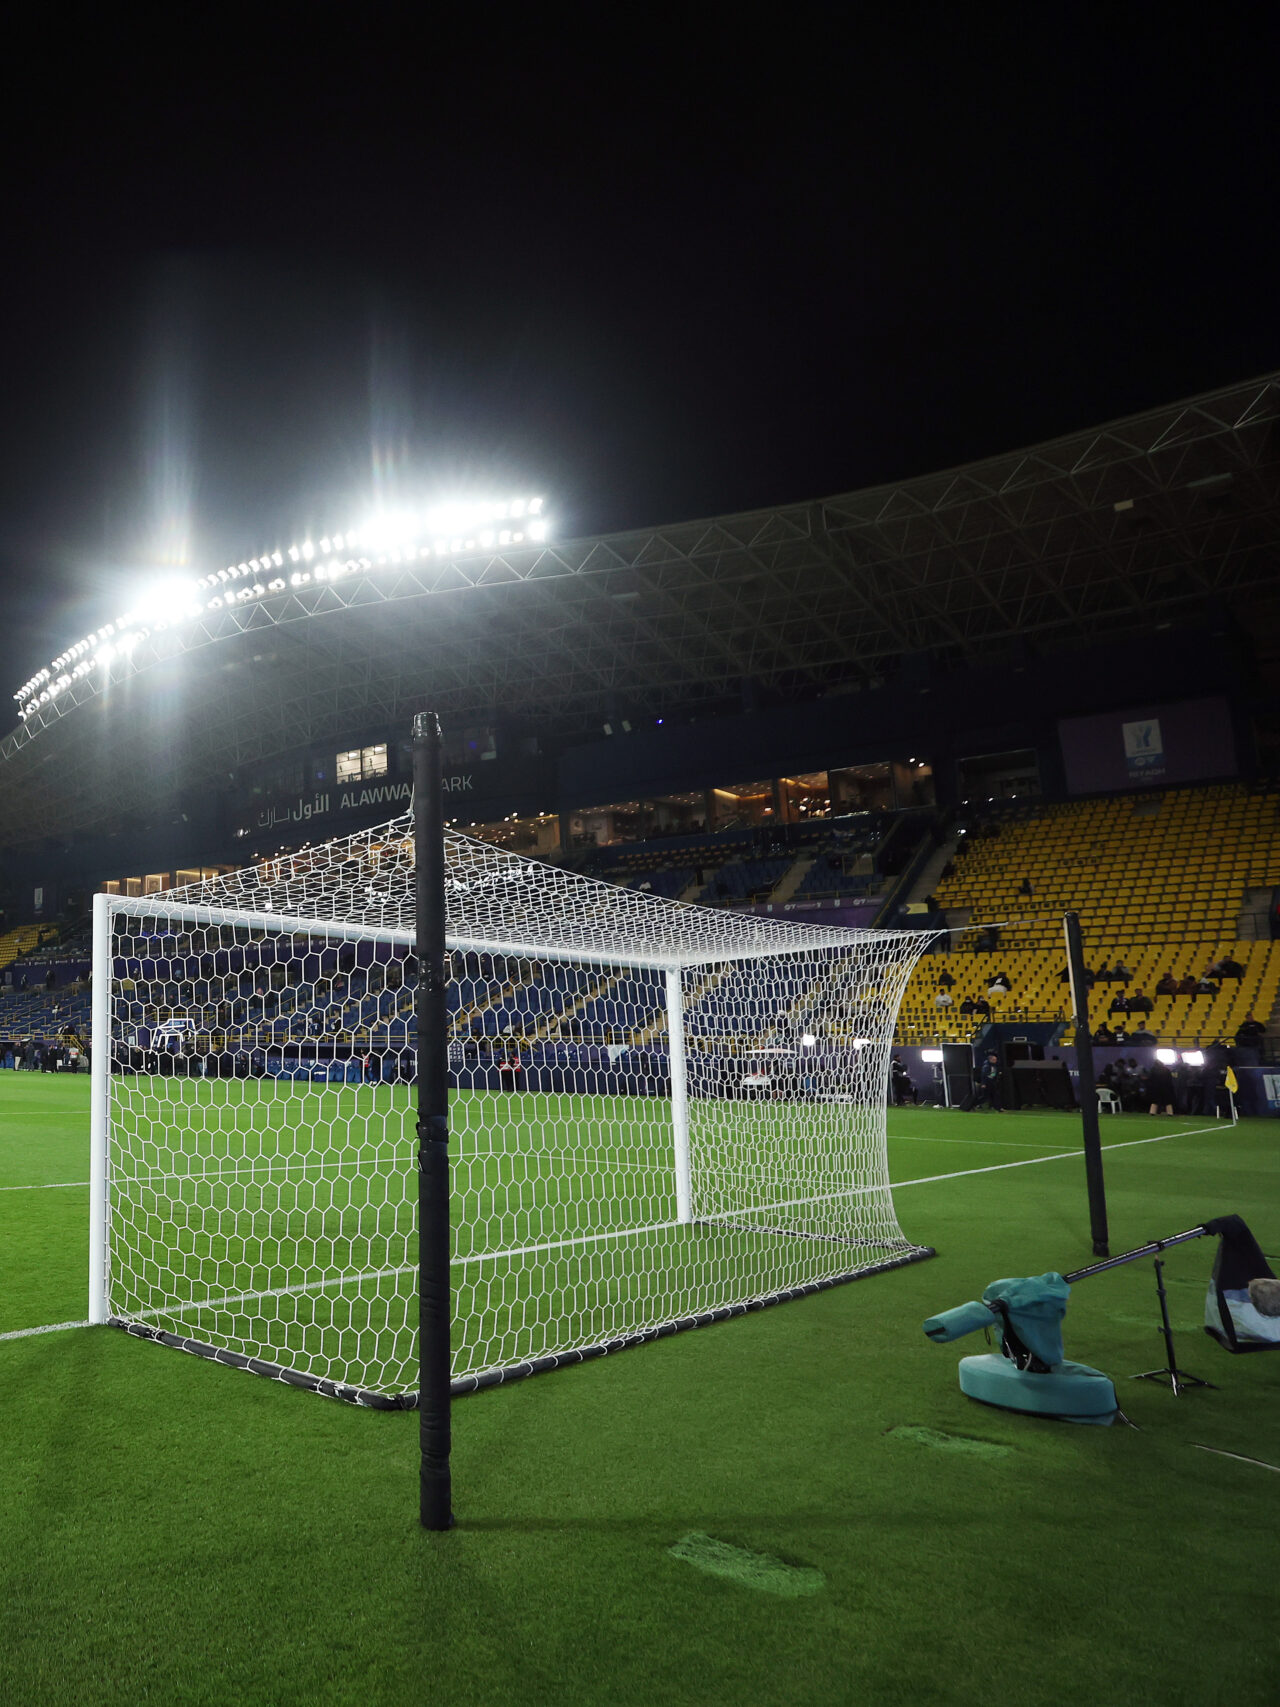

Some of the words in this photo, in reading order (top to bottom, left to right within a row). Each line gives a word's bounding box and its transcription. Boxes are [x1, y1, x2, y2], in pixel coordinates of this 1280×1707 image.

[293, 793, 330, 821] الأول
[340, 783, 412, 809] ALAWWA
[441, 775, 474, 793] ARK
